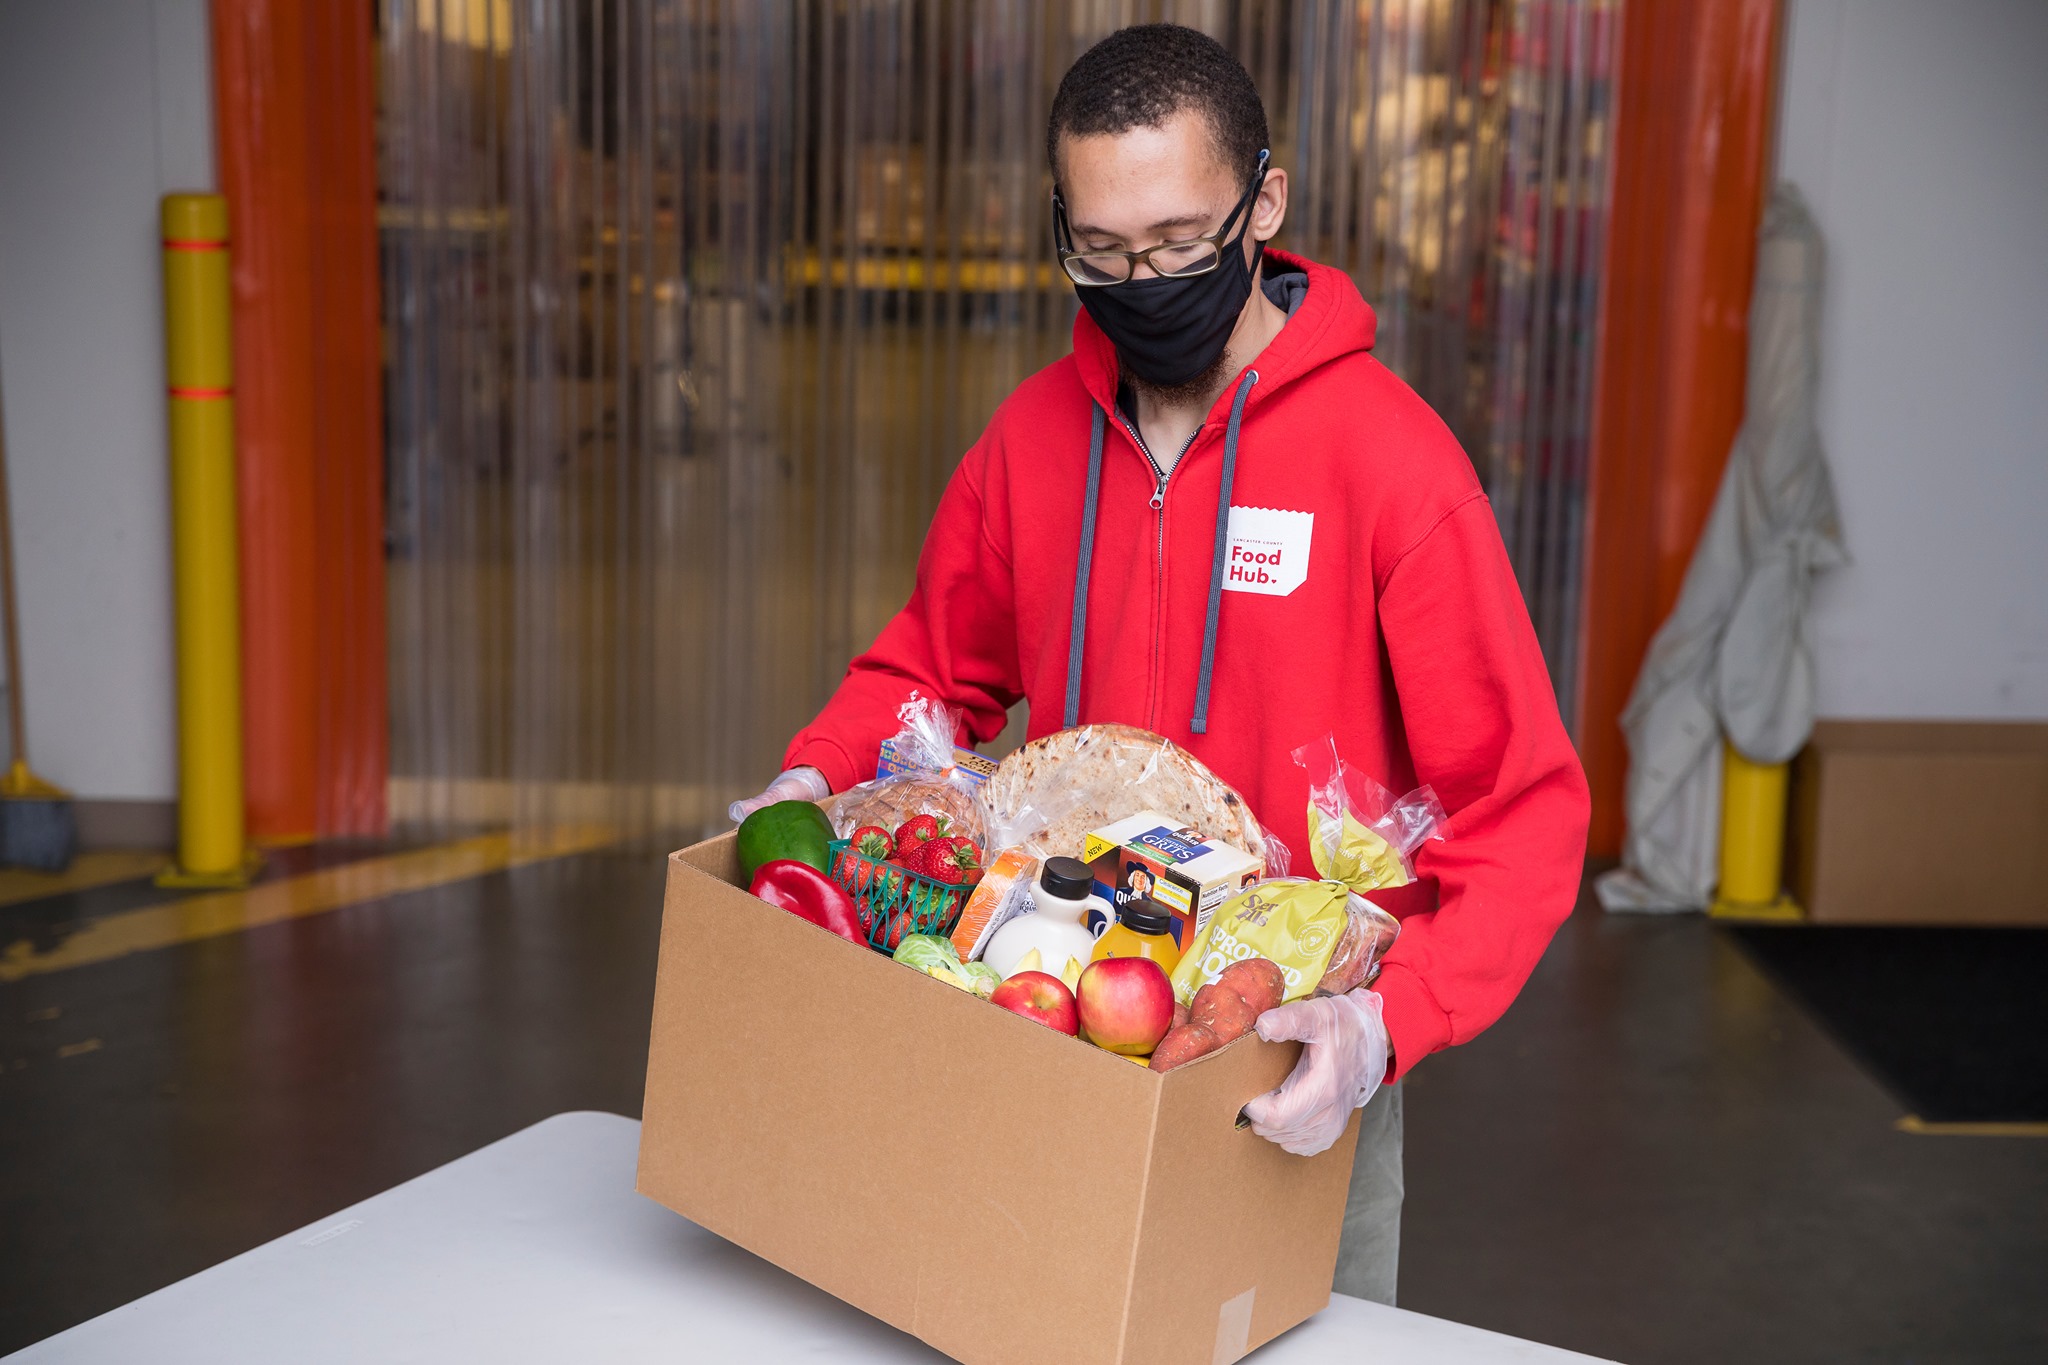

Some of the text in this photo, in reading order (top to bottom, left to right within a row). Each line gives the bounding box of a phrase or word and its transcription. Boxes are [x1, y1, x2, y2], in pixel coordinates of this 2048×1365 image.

[1231, 545, 1282, 566] Food
[1142, 834, 1194, 859] GRITS
[1172, 831, 1199, 846] QUAKER
[1087, 843, 1103, 857] NEW
